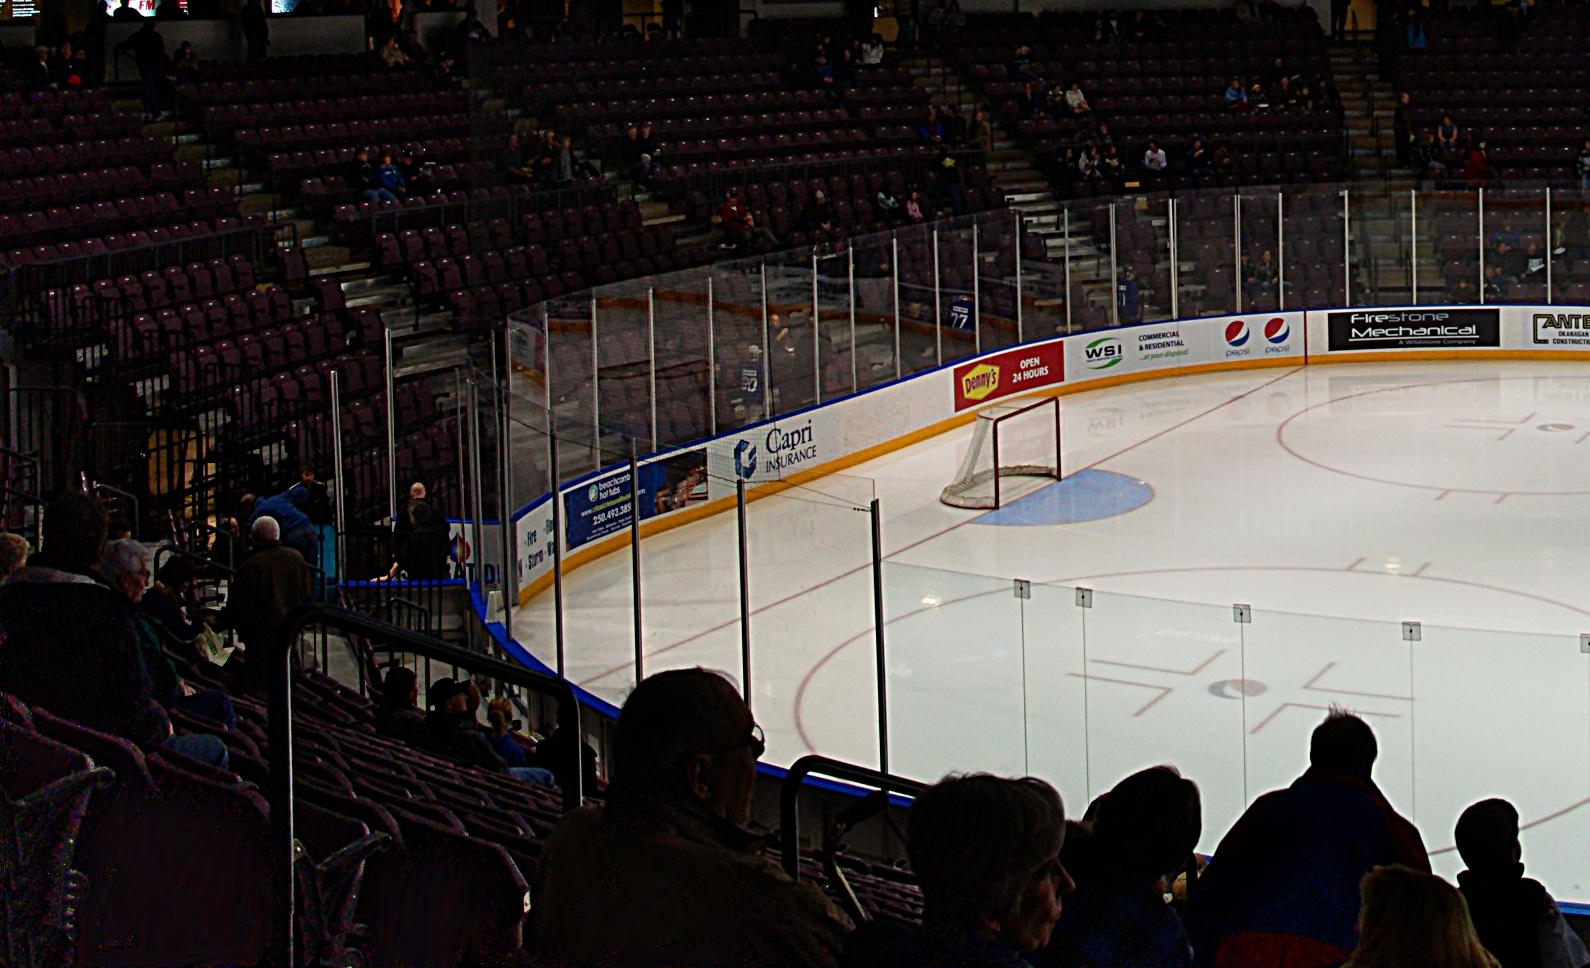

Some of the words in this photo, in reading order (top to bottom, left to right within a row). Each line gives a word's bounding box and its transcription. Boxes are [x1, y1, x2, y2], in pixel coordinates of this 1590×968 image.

[139, 0, 156, 11] FM
[951, 312, 969, 329] 77
[1350, 311, 1449, 325] Firestone
[1138, 331, 1180, 342] COMMERCIAL
[1351, 324, 1477, 338] Mechanical
[1085, 344, 1122, 359] WSI
[1144, 340, 1185, 350] RESIDENTIAL
[1265, 345, 1290, 355] pepsi
[1225, 348, 1250, 358] pepsi
[1019, 356, 1041, 370] OPEN
[964, 368, 997, 394] Denny's
[1012, 371, 1022, 383] 24
[1022, 365, 1049, 381] HOURS
[766, 420, 814, 455] Capri
[766, 445, 817, 473] INSURANCE
